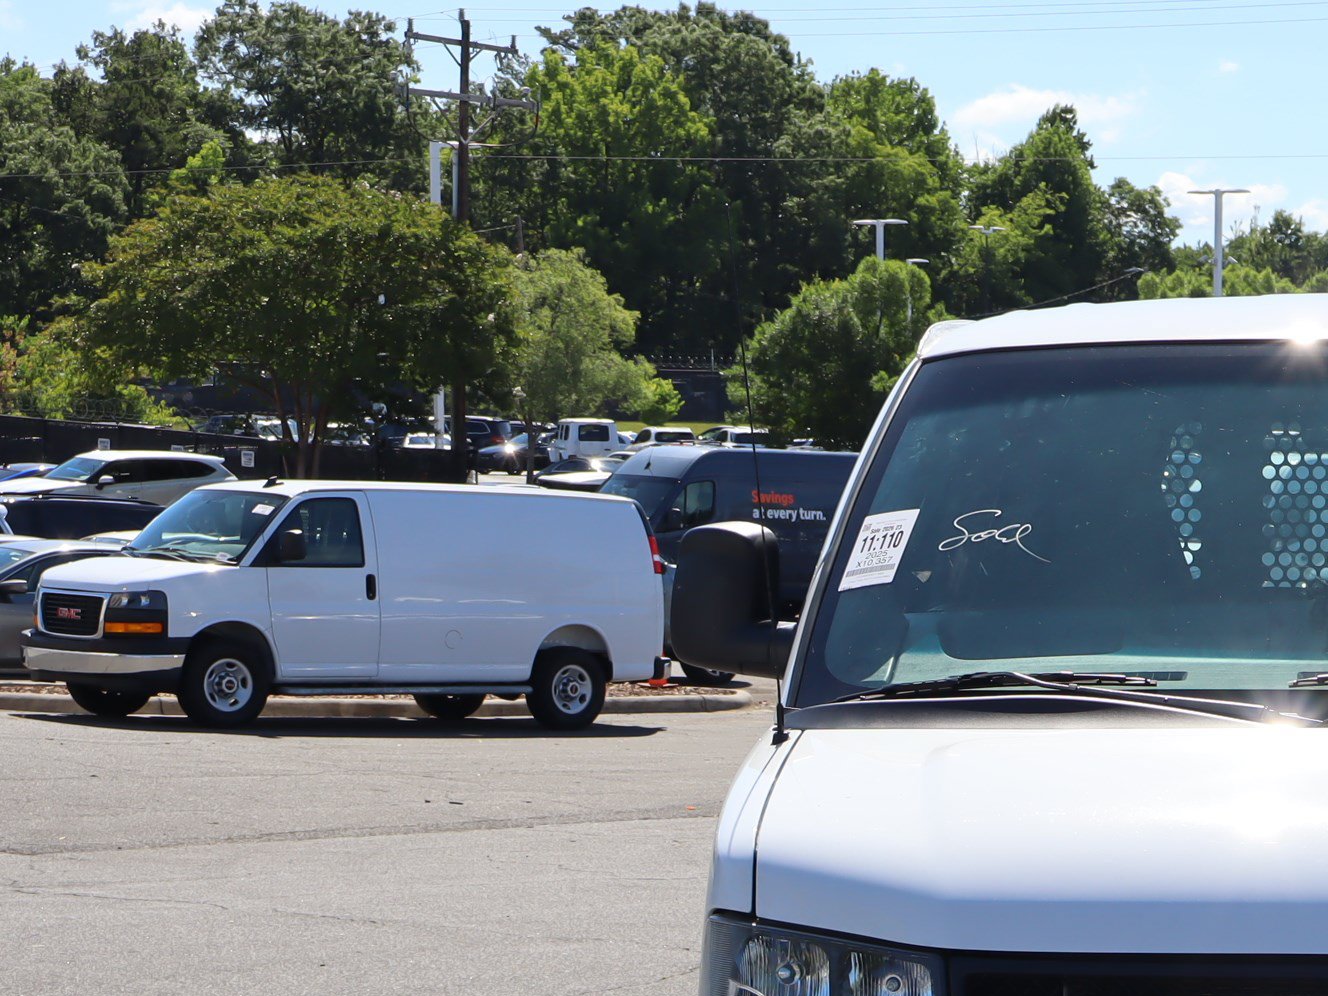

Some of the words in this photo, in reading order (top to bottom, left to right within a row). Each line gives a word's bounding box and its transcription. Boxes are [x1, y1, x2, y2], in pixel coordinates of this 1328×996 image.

[751, 490, 795, 507] Savings
[766, 508, 797, 522] every
[799, 507, 826, 520] turn.
[860, 530, 904, 553] 11:110
[865, 550, 888, 560] 2025
[57, 607, 81, 619] GMC
